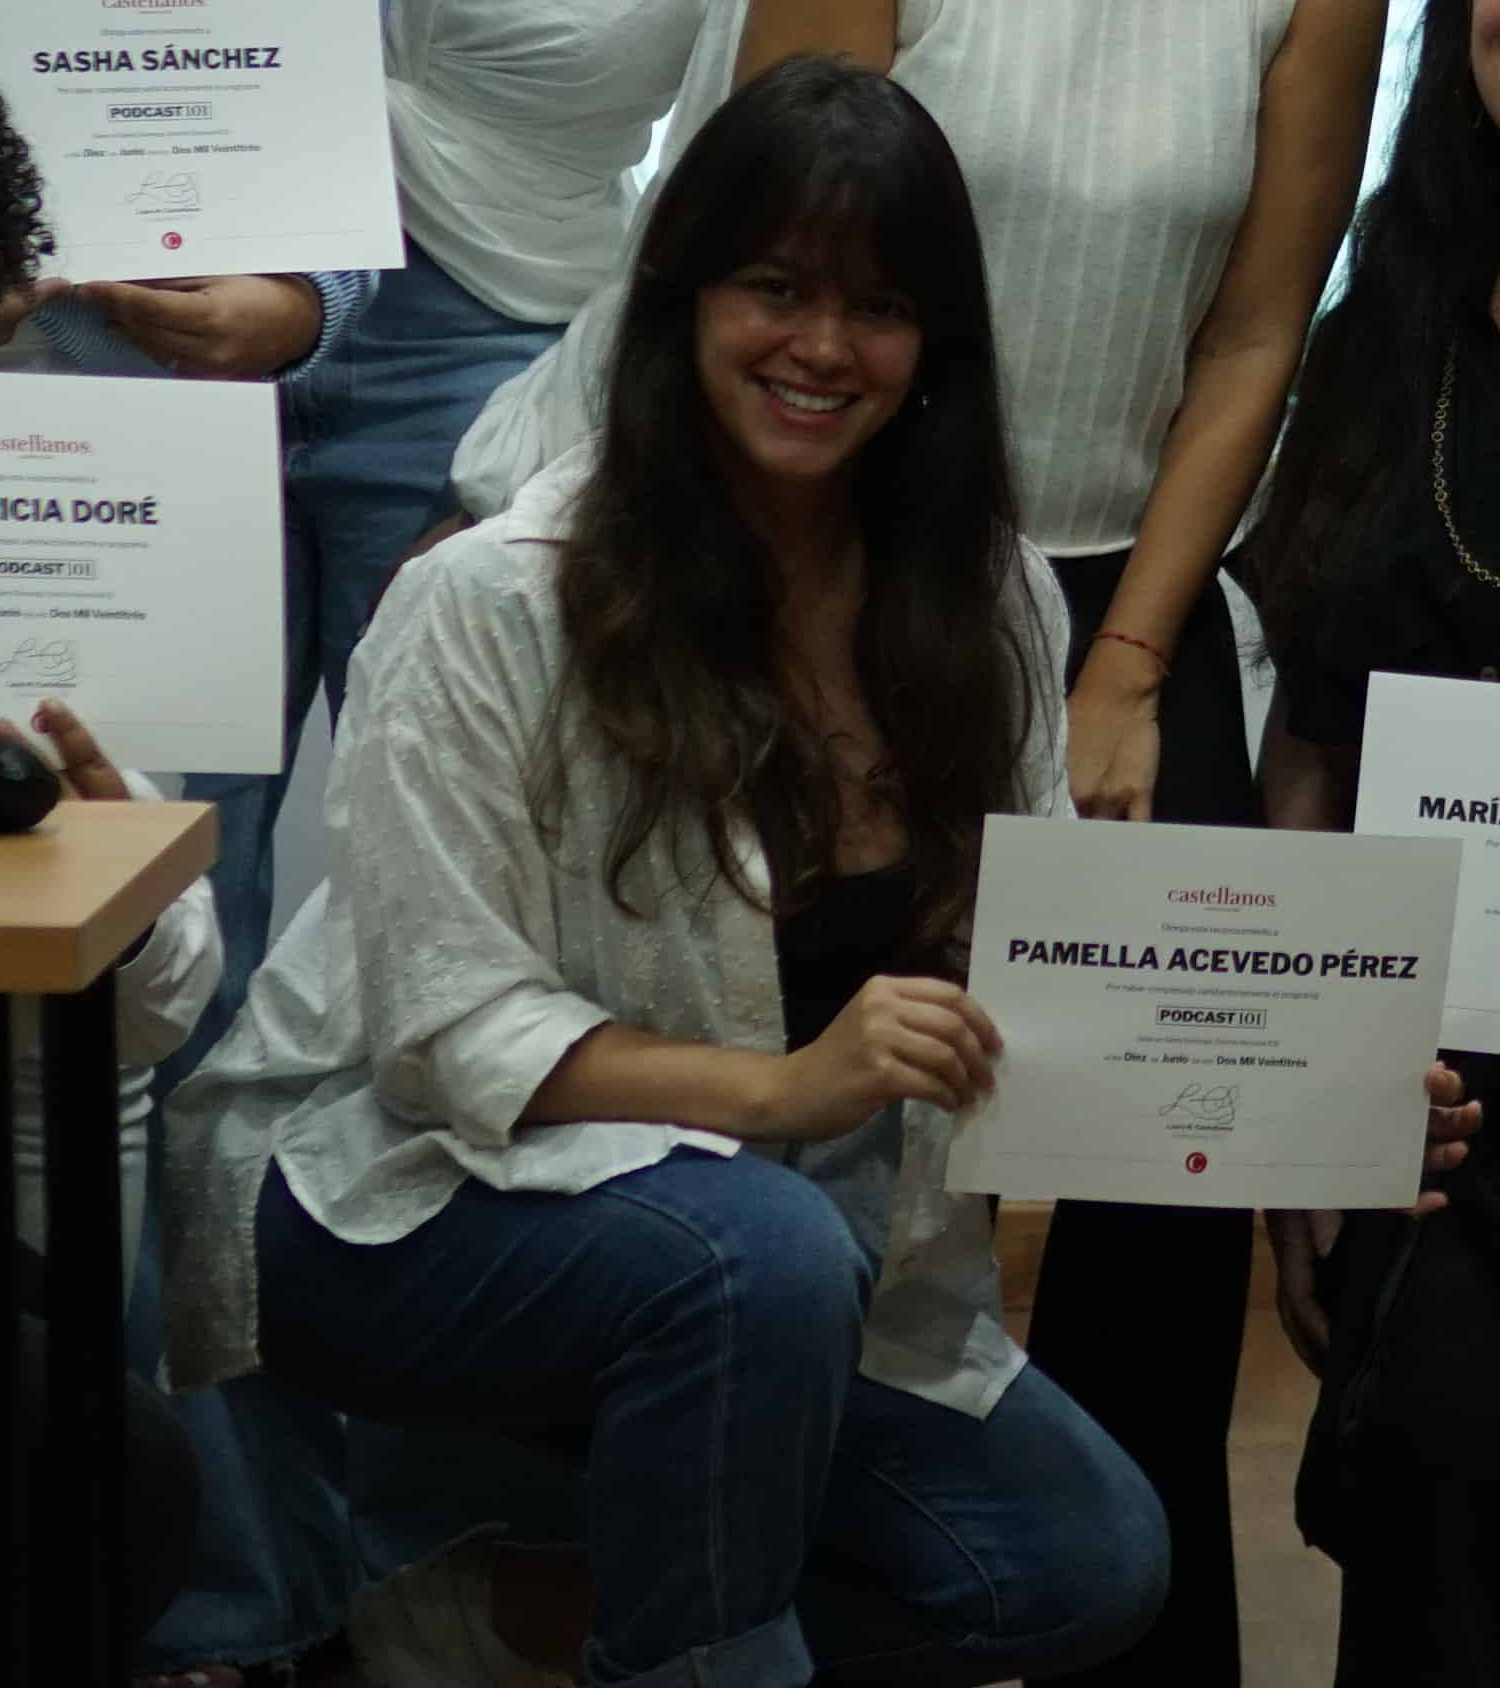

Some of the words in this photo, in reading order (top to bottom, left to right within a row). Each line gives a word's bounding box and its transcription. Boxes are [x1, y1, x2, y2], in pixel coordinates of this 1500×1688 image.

[33, 50, 135, 73] SASHA
[141, 44, 281, 72] SÁNCHEZ
[110, 106, 182, 119] PODCAST
[186, 105, 208, 117] 101
[72, 495, 159, 525] DORÉ
[67, 562, 92, 576] 101
[1167, 885, 1276, 907] castellanos
[1007, 939, 1159, 970] PAMELLA
[1167, 947, 1313, 977] ACEVEDO
[1319, 949, 1419, 979] PÉREZ
[1160, 1009, 1236, 1025] PODCAST
[1239, 1011, 1262, 1025] 101
